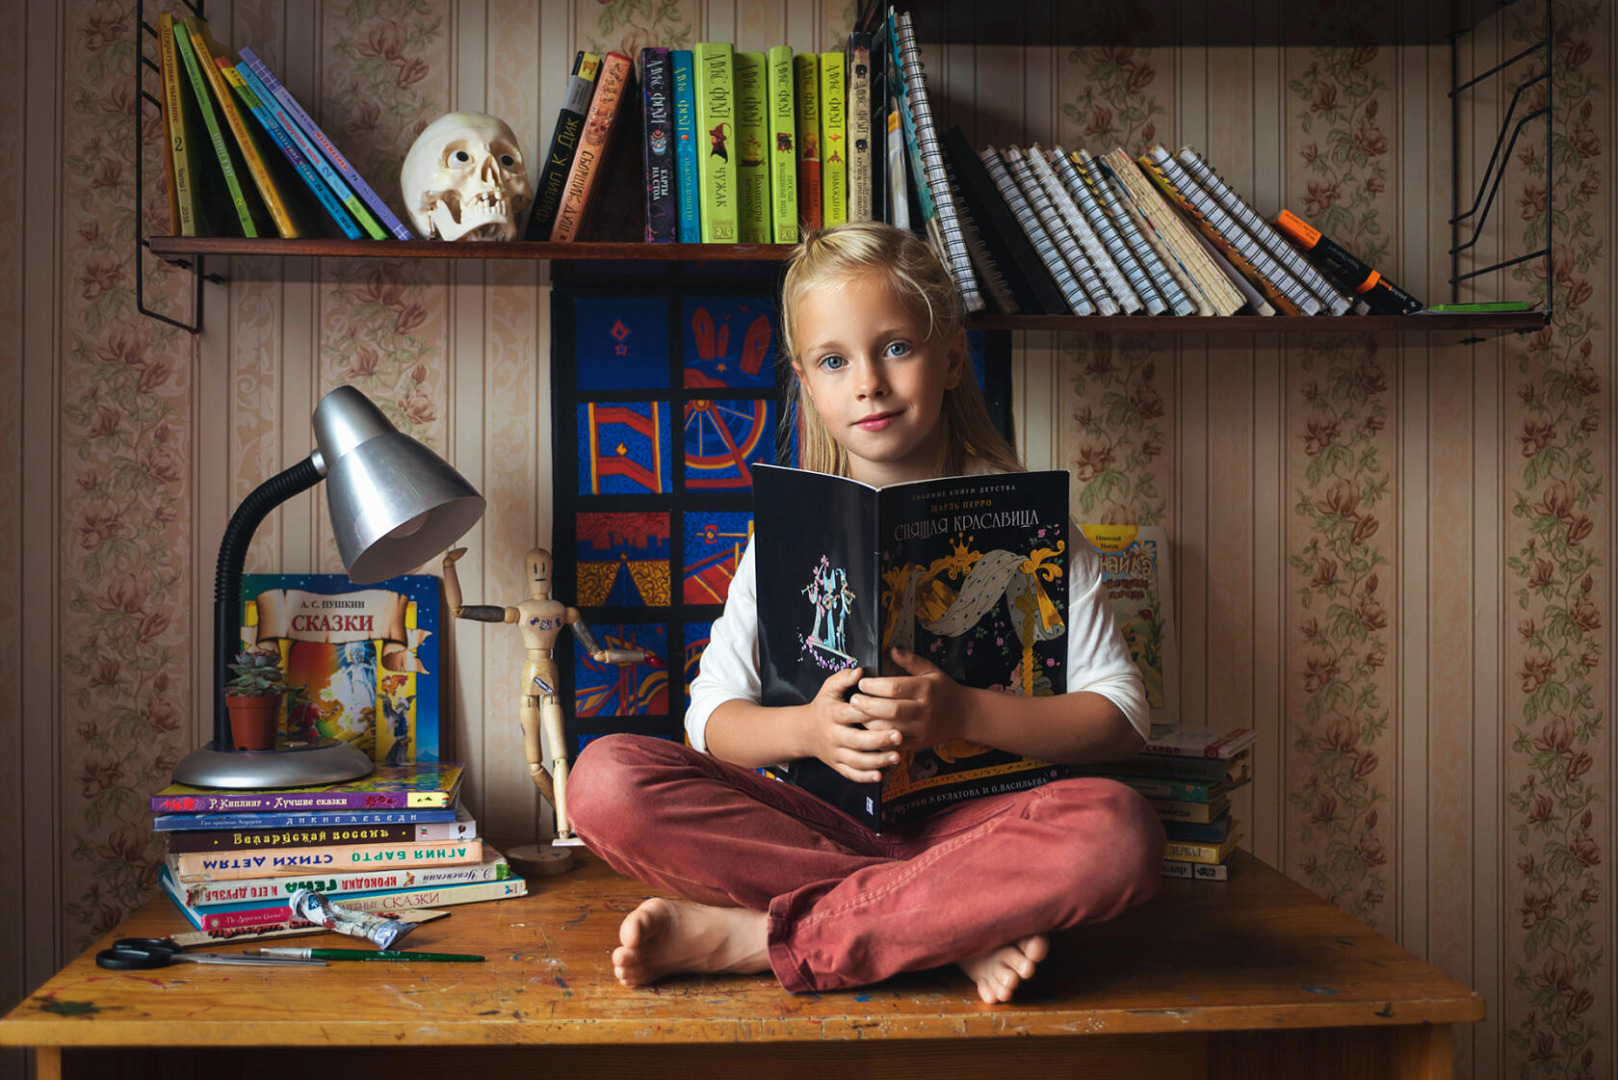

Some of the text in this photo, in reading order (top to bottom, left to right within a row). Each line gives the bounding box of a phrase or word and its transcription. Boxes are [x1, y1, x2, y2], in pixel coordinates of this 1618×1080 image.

[704, 52, 730, 118] МАКС ФРАЙ
[174, 136, 183, 152] 2
[315, 132, 348, 170] МАТЕМАТИКА
[322, 166, 332, 178] 2
[651, 166, 660, 200] НА СТОЛ
[659, 169, 668, 195] КАРТЫ
[713, 166, 726, 207] ЧУЖАК
[558, 149, 594, 232] СБОРЩИК ДУШ
[979, 484, 1016, 494] ДЕТСТВА
[962, 499, 992, 510] ПЕРРО
[894, 509, 1039, 541] СПЯЩАЯ КРАСАВИЦА
[301, 600, 365, 609] А. С. ПУШКИН
[292, 614, 374, 632] СКАЗКИ
[274, 797, 314, 808] Лучшие
[316, 798, 348, 806] сказки
[286, 814, 416, 826] ДИКИЕ ЛЕБЕДИ
[203, 848, 466, 870] АГНИЯ БАРТО СТИХИ ДЕТЯМ
[342, 876, 397, 891] КРОКОДИЛ
[422, 868, 479, 884] Успенский
[204, 886, 248, 902] ДРУЗЬЯ
[250, 886, 268, 898] ЕГО
[270, 886, 278, 896] И
[285, 879, 338, 893] ГЕНА
[382, 892, 440, 910] СКАЗКИ
